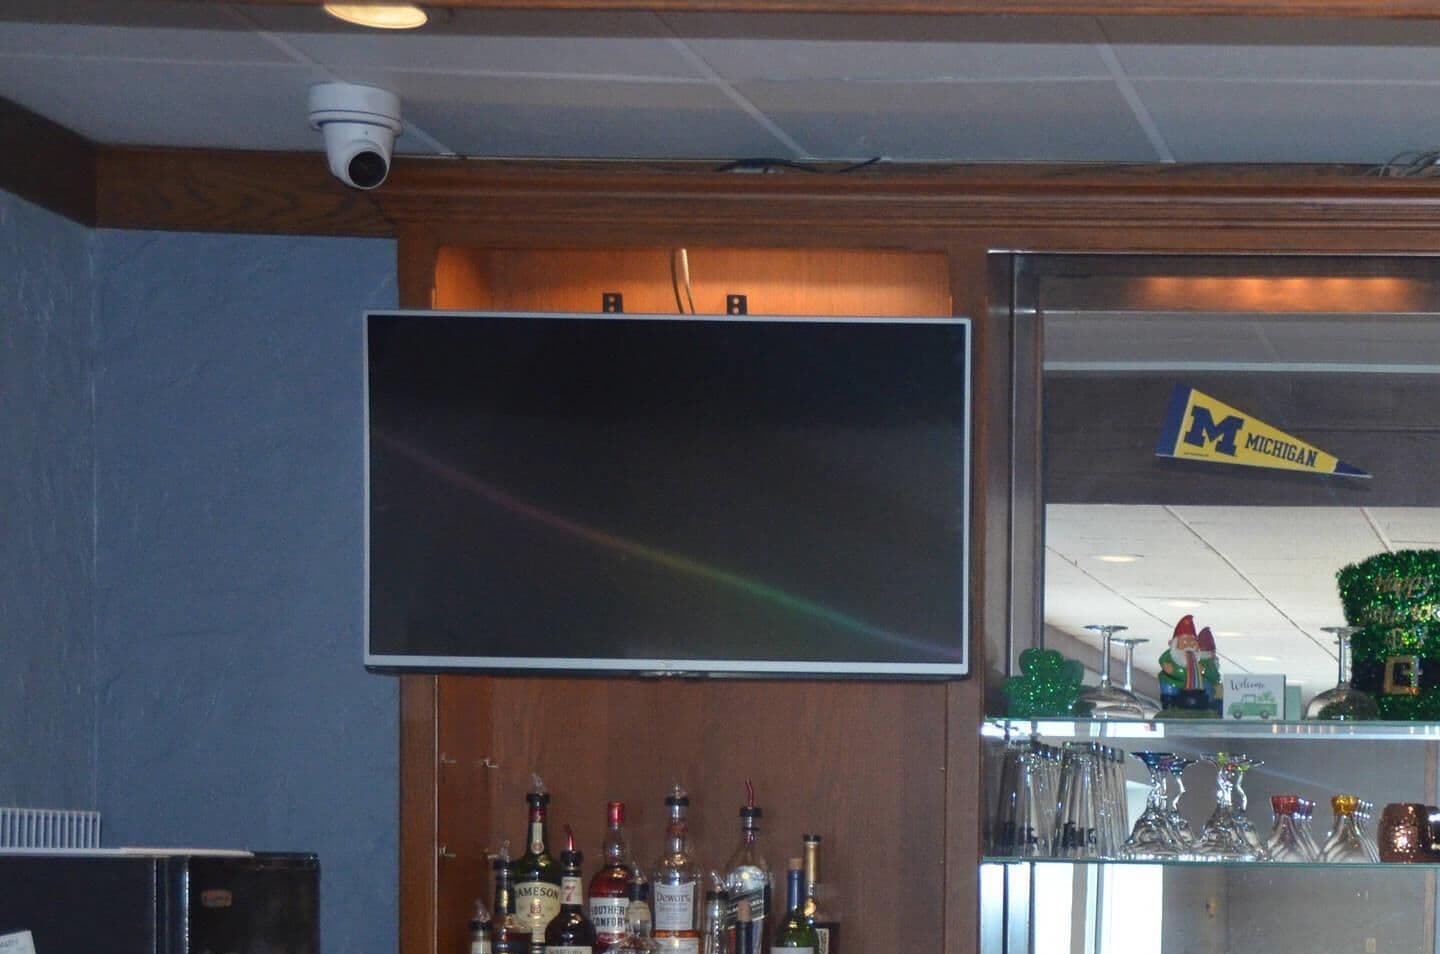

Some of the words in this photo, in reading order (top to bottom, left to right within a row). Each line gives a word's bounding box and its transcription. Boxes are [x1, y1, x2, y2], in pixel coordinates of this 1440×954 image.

[1183, 405, 1244, 457] M
[1244, 432, 1318, 468] MICHIGAN
[1230, 675, 1265, 691] Welcome
[563, 885, 576, 902] 7
